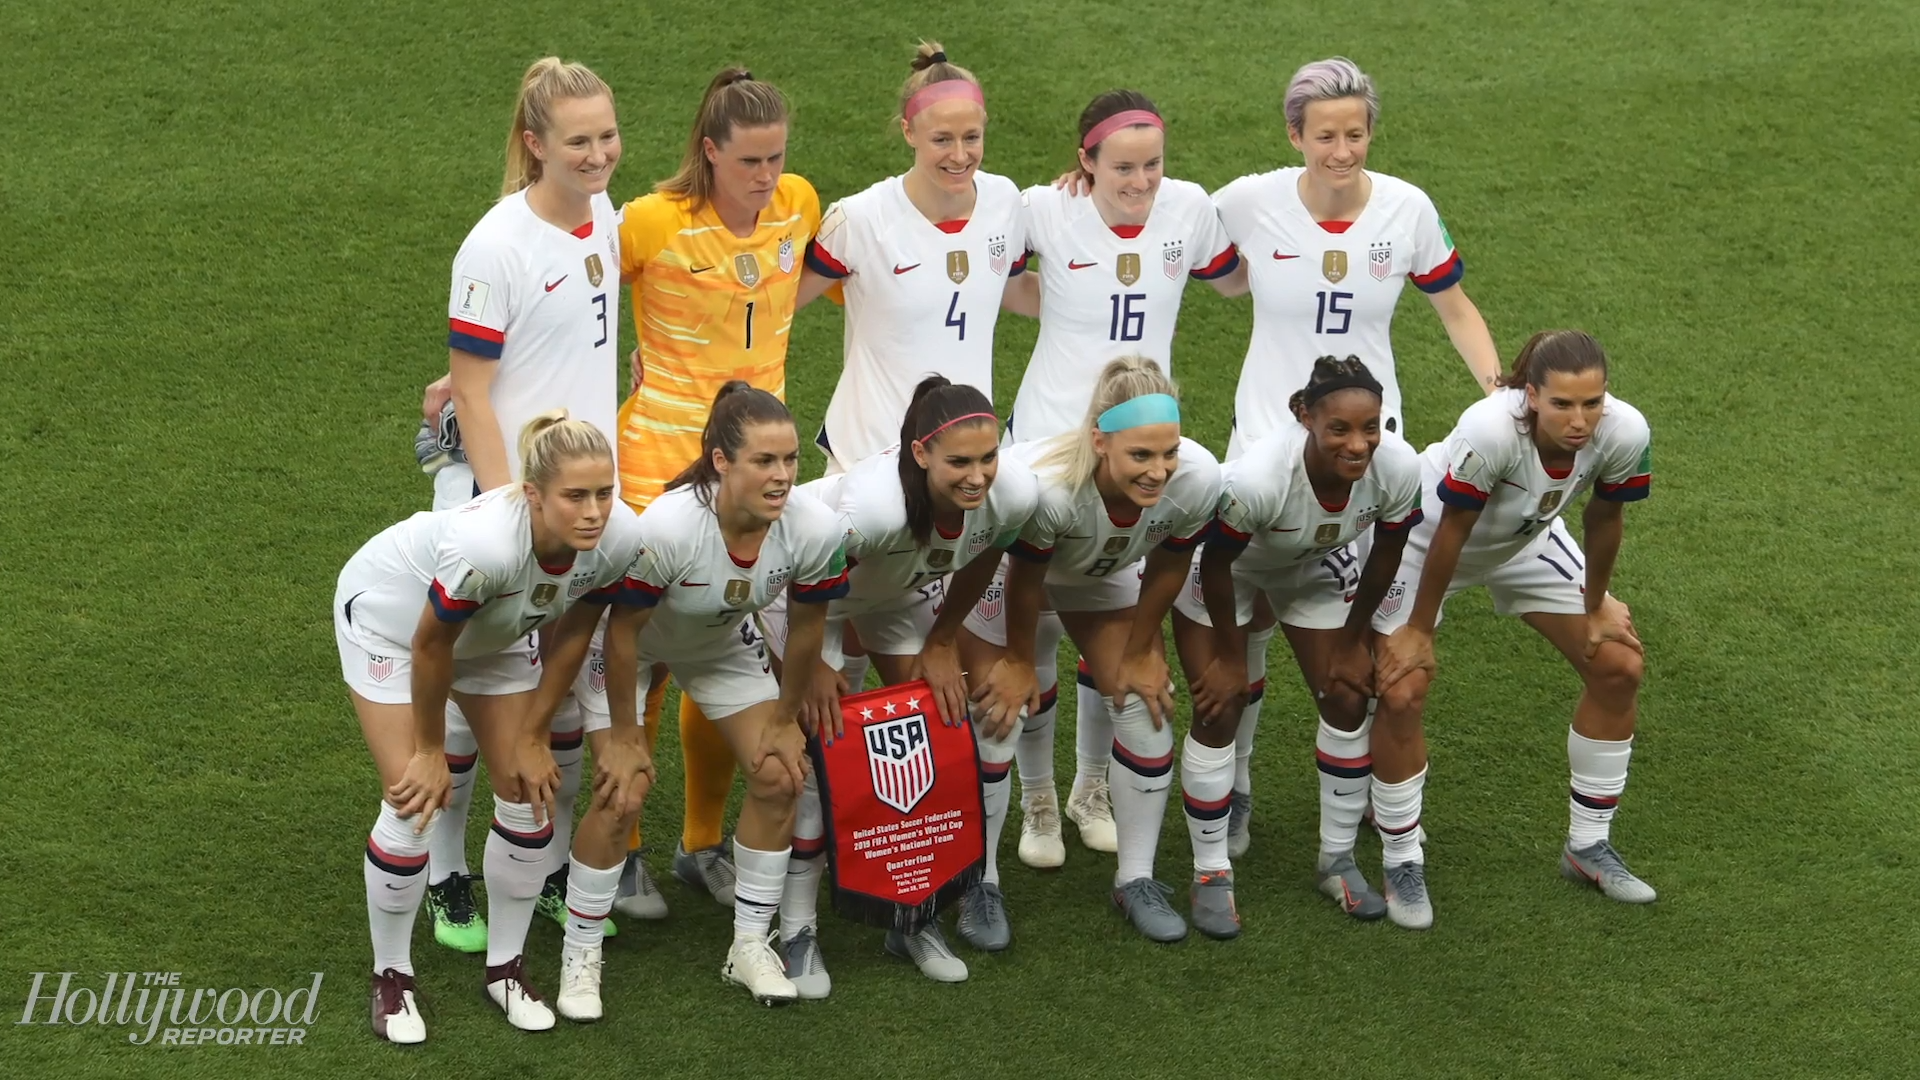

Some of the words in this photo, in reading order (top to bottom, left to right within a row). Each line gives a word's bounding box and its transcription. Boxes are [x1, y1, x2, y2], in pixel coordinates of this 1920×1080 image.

[779, 241, 792, 256] USA
[990, 243, 1005, 258] USA
[1165, 249, 1182, 263] USA
[1371, 251, 1390, 264] USA
[591, 293, 607, 348] 3
[945, 291, 966, 341] 4
[1109, 293, 1146, 341] 16
[1315, 291, 1353, 334] 15
[745, 301, 754, 349] 1
[1149, 525, 1170, 534] USA
[1084, 558, 1118, 577] 8
[573, 577, 594, 588] USA
[769, 572, 789, 585] USA
[1386, 588, 1402, 599] SA
[518, 613, 547, 640] 7
[706, 608, 743, 628] 5
[591, 660, 605, 674] US
[868, 720, 924, 760] USA
[853, 827, 876, 840] United
[876, 823, 899, 834] States
[900, 818, 923, 829] Soccer
[924, 809, 962, 823] Federation
[853, 840, 871, 851] 2019
[872, 836, 888, 847] FIFA
[889, 830, 923, 843] Women's
[924, 824, 948, 835] World
[949, 820, 963, 830] Cup
[864, 846, 899, 860] Women's
[900, 837, 933, 852] National
[934, 833, 954, 844] Team
[886, 852, 934, 872] Quarterfinal
